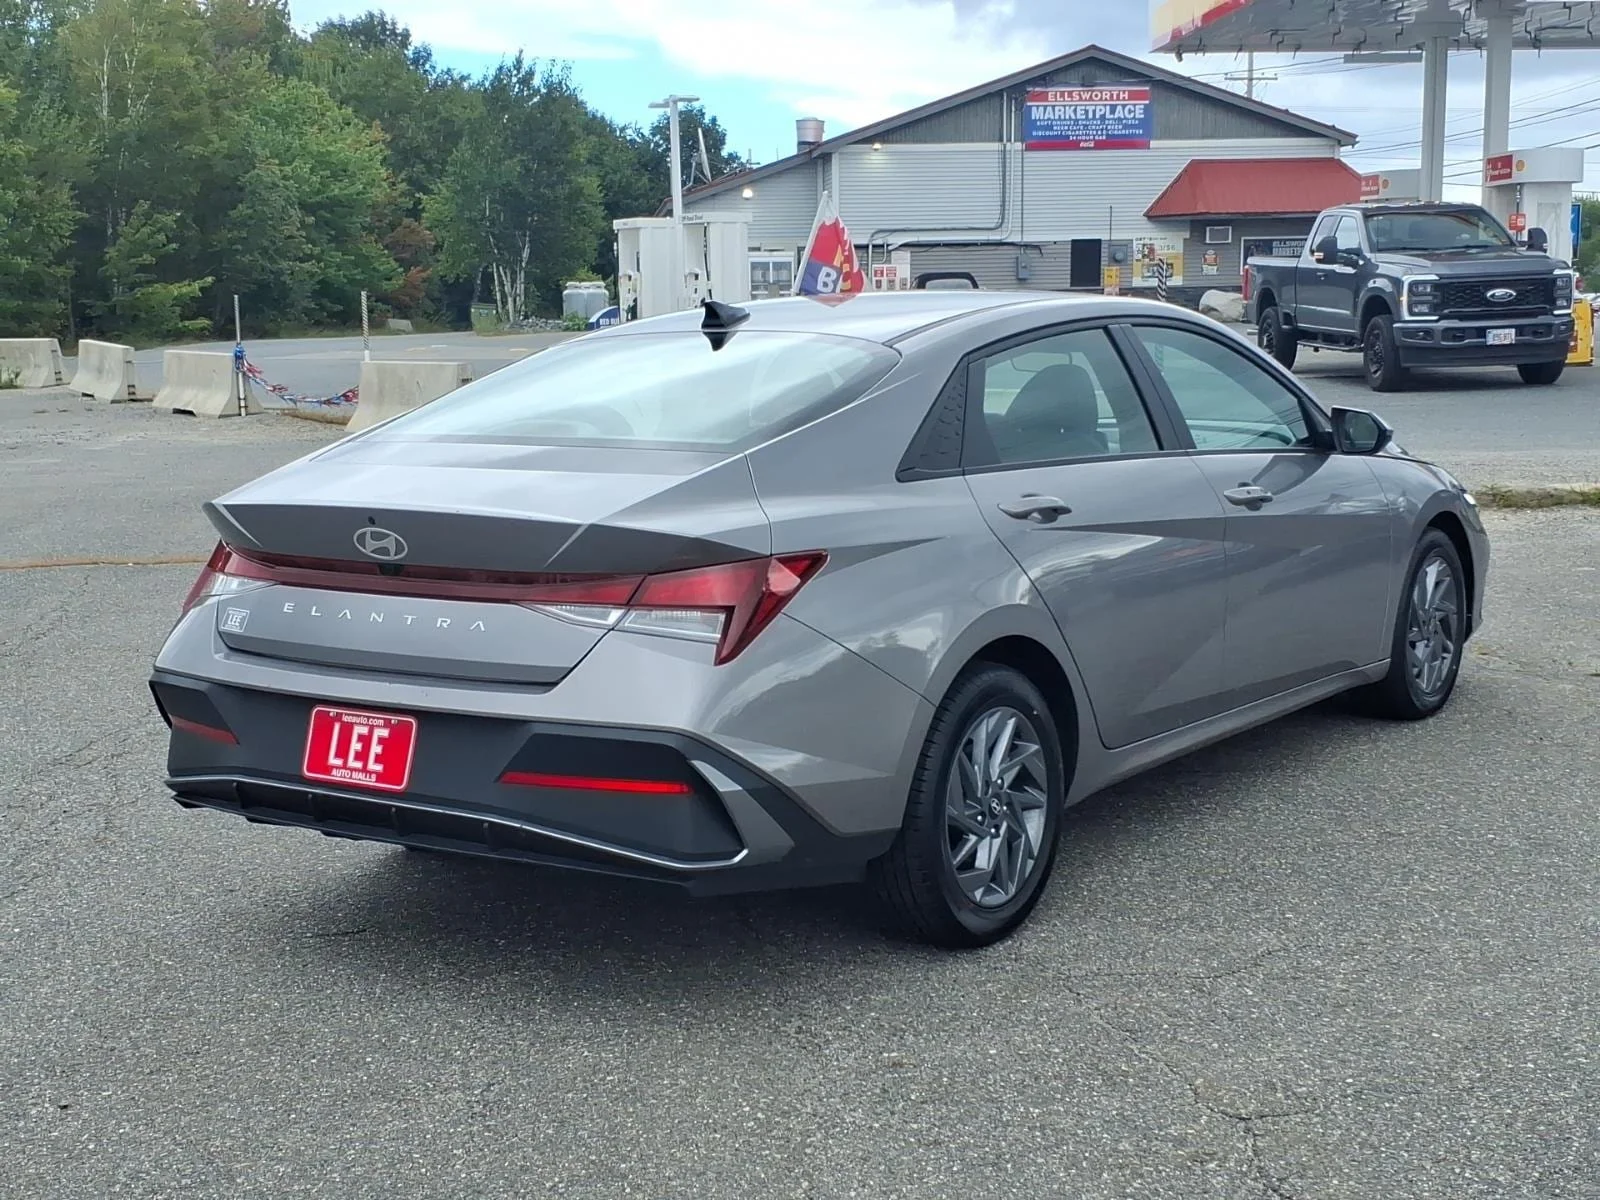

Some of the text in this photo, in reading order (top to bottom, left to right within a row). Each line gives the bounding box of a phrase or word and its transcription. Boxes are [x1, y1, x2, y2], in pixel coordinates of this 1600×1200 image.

[1047, 90, 1128, 101] ELLSWORTH
[1031, 104, 1145, 120] MARKETPLACE
[228, 614, 242, 626] LEE
[283, 602, 486, 631] ELANTRA
[342, 713, 384, 726] leeauto.com
[328, 721, 390, 773] LEE
[331, 768, 376, 783] AUTO MALLS
